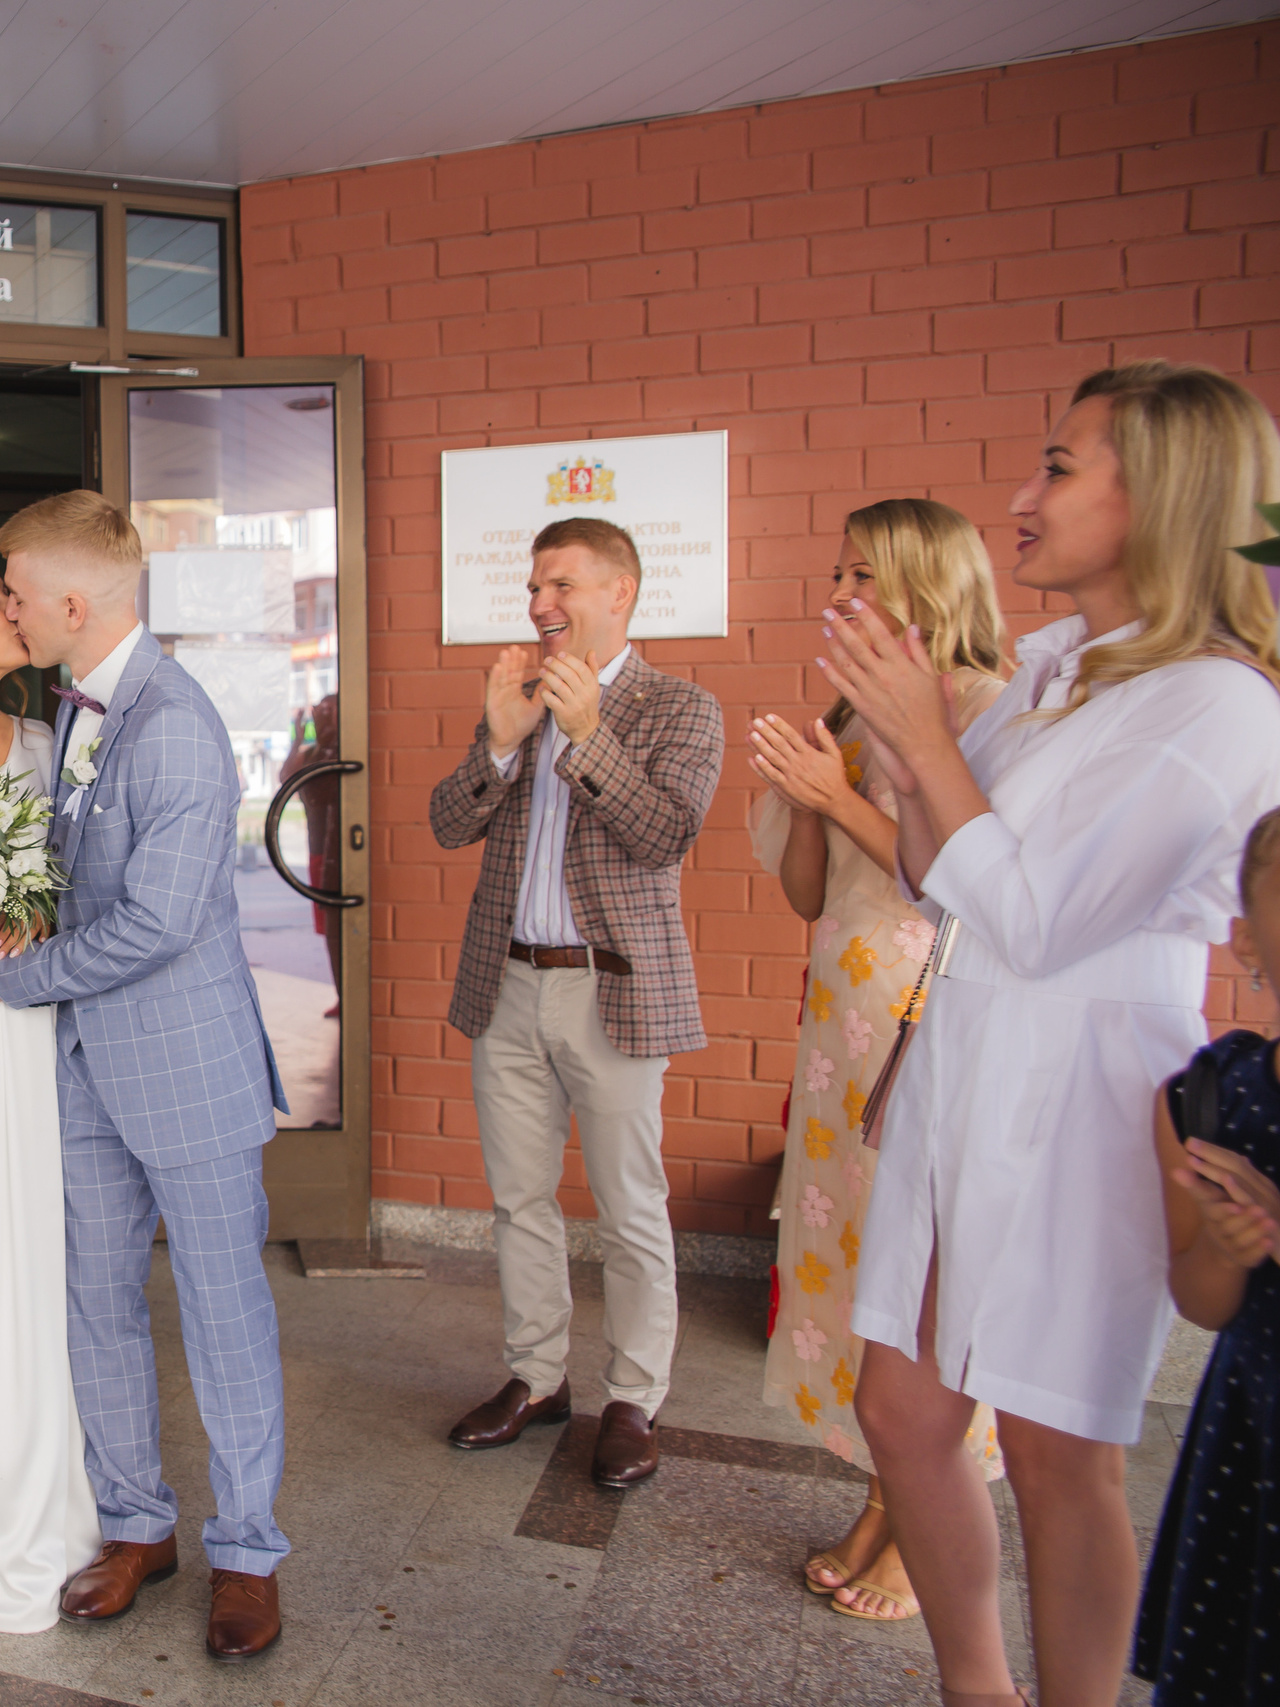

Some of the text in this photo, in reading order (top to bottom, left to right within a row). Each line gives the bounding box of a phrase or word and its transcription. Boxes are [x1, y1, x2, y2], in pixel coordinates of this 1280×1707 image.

[636, 541, 712, 558] ТОЯНИЯ
[481, 564, 683, 586] ЛЕНИ ОНА
[490, 593, 527, 607] ГОРО
